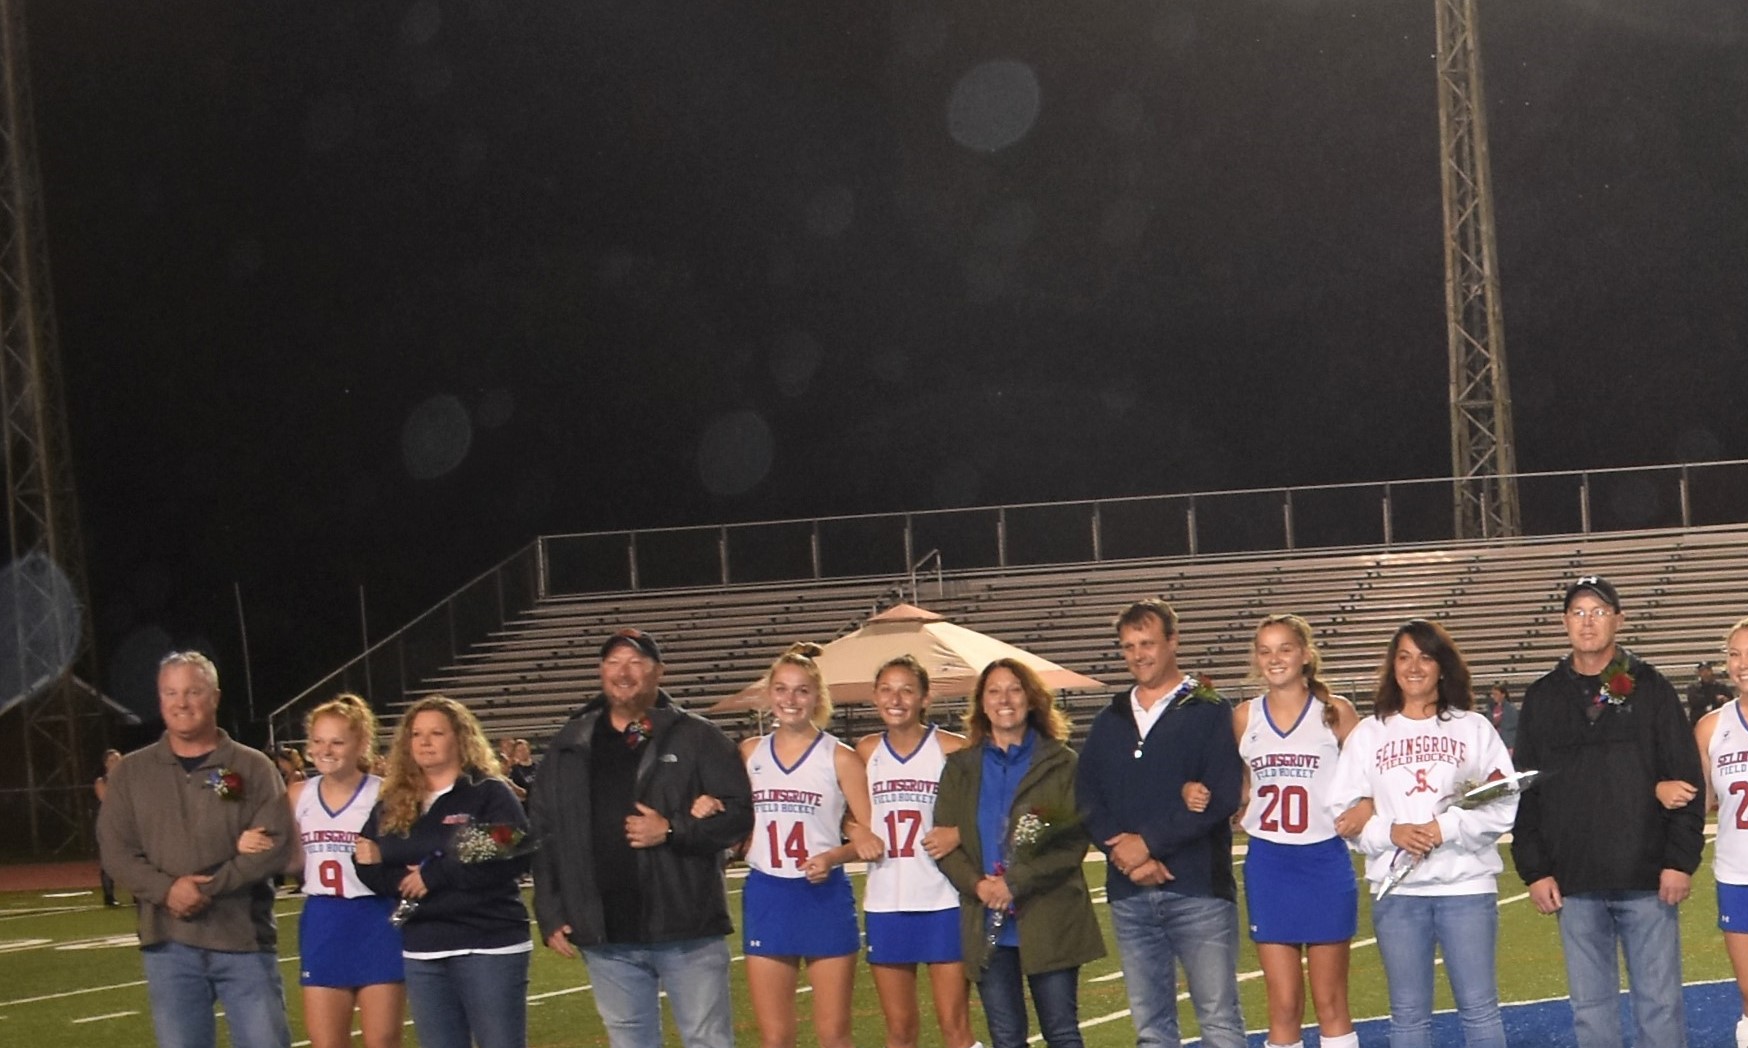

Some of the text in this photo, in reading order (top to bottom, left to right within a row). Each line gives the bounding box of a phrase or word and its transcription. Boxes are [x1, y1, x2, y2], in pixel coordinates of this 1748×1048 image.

[1250, 753, 1320, 772] SELINSGROVE
[1376, 735, 1466, 768] SELINSGROVE
[1279, 768, 1315, 778] HOCKEY
[1380, 753, 1461, 775] FIELD HOCKEY
[1720, 763, 1747, 776] FIELD
[872, 779, 940, 796] SELINSGROVE
[1257, 784, 1308, 833] 20
[767, 820, 809, 869] 14
[884, 809, 922, 858] 17
[326, 843, 356, 853] HOCKE
[319, 860, 344, 897] 9
